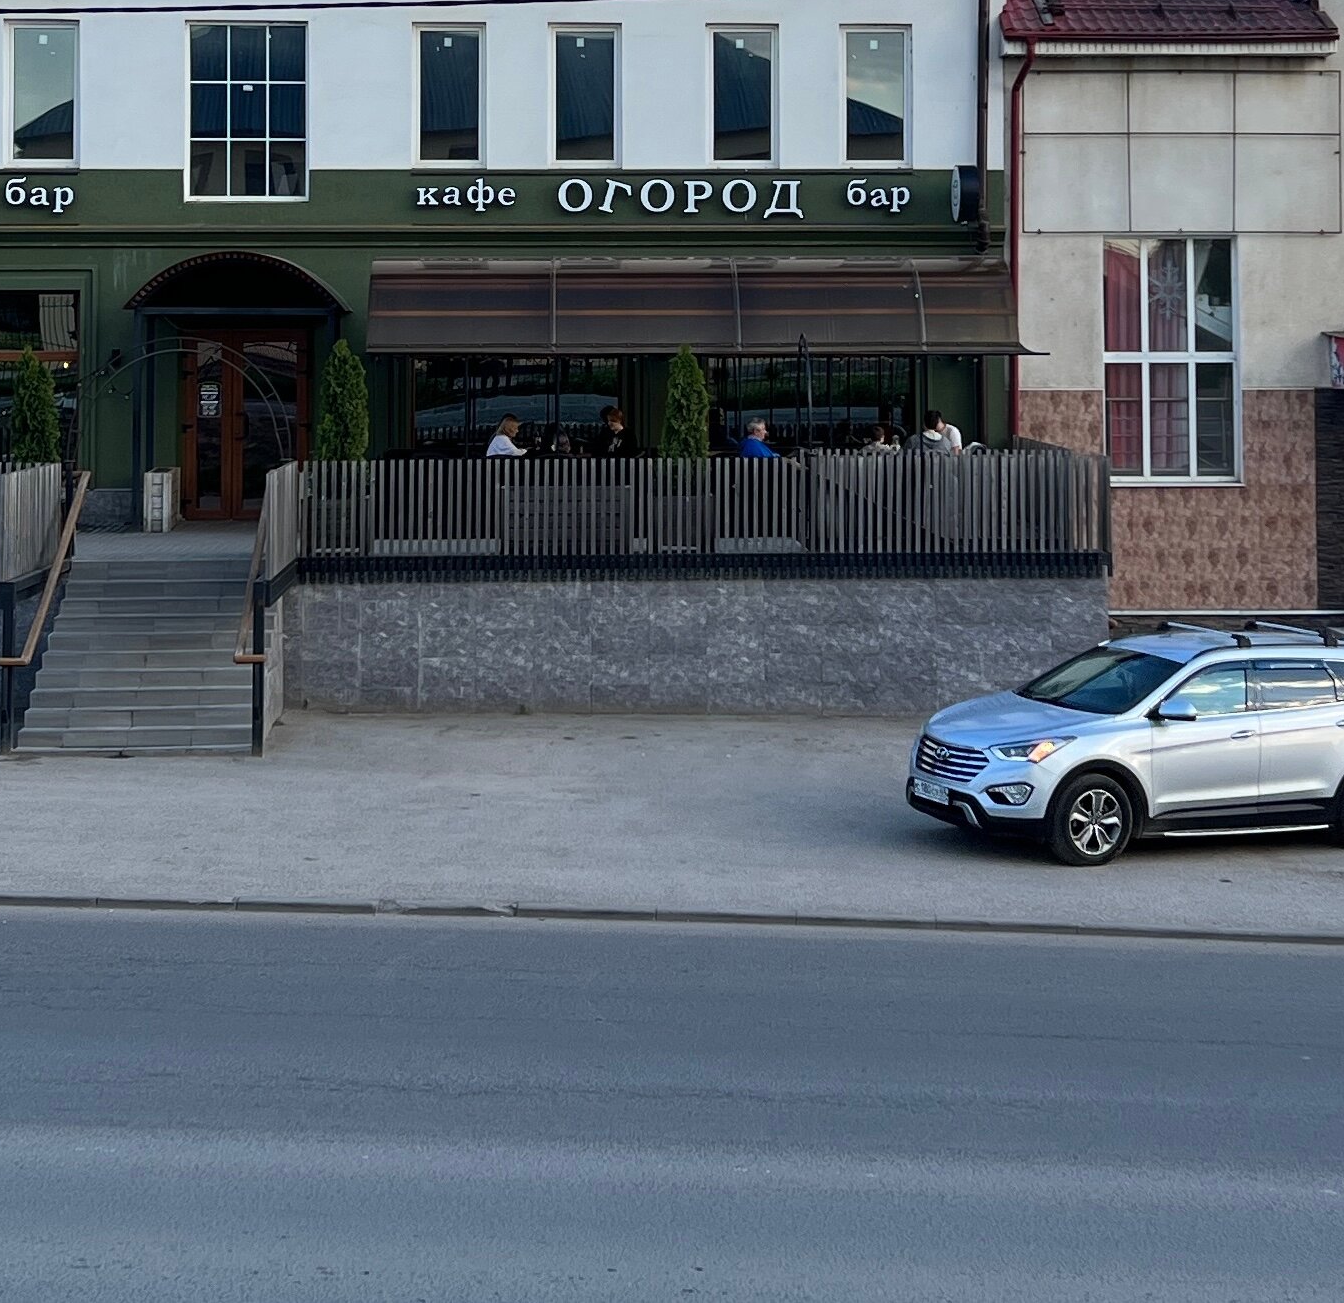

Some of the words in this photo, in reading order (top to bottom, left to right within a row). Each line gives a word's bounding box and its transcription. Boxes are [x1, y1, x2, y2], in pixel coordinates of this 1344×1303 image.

[5, 176, 75, 213] бар
[415, 178, 517, 212] кафе
[557, 177, 805, 219] ОГОРОД
[845, 178, 911, 213] бар
